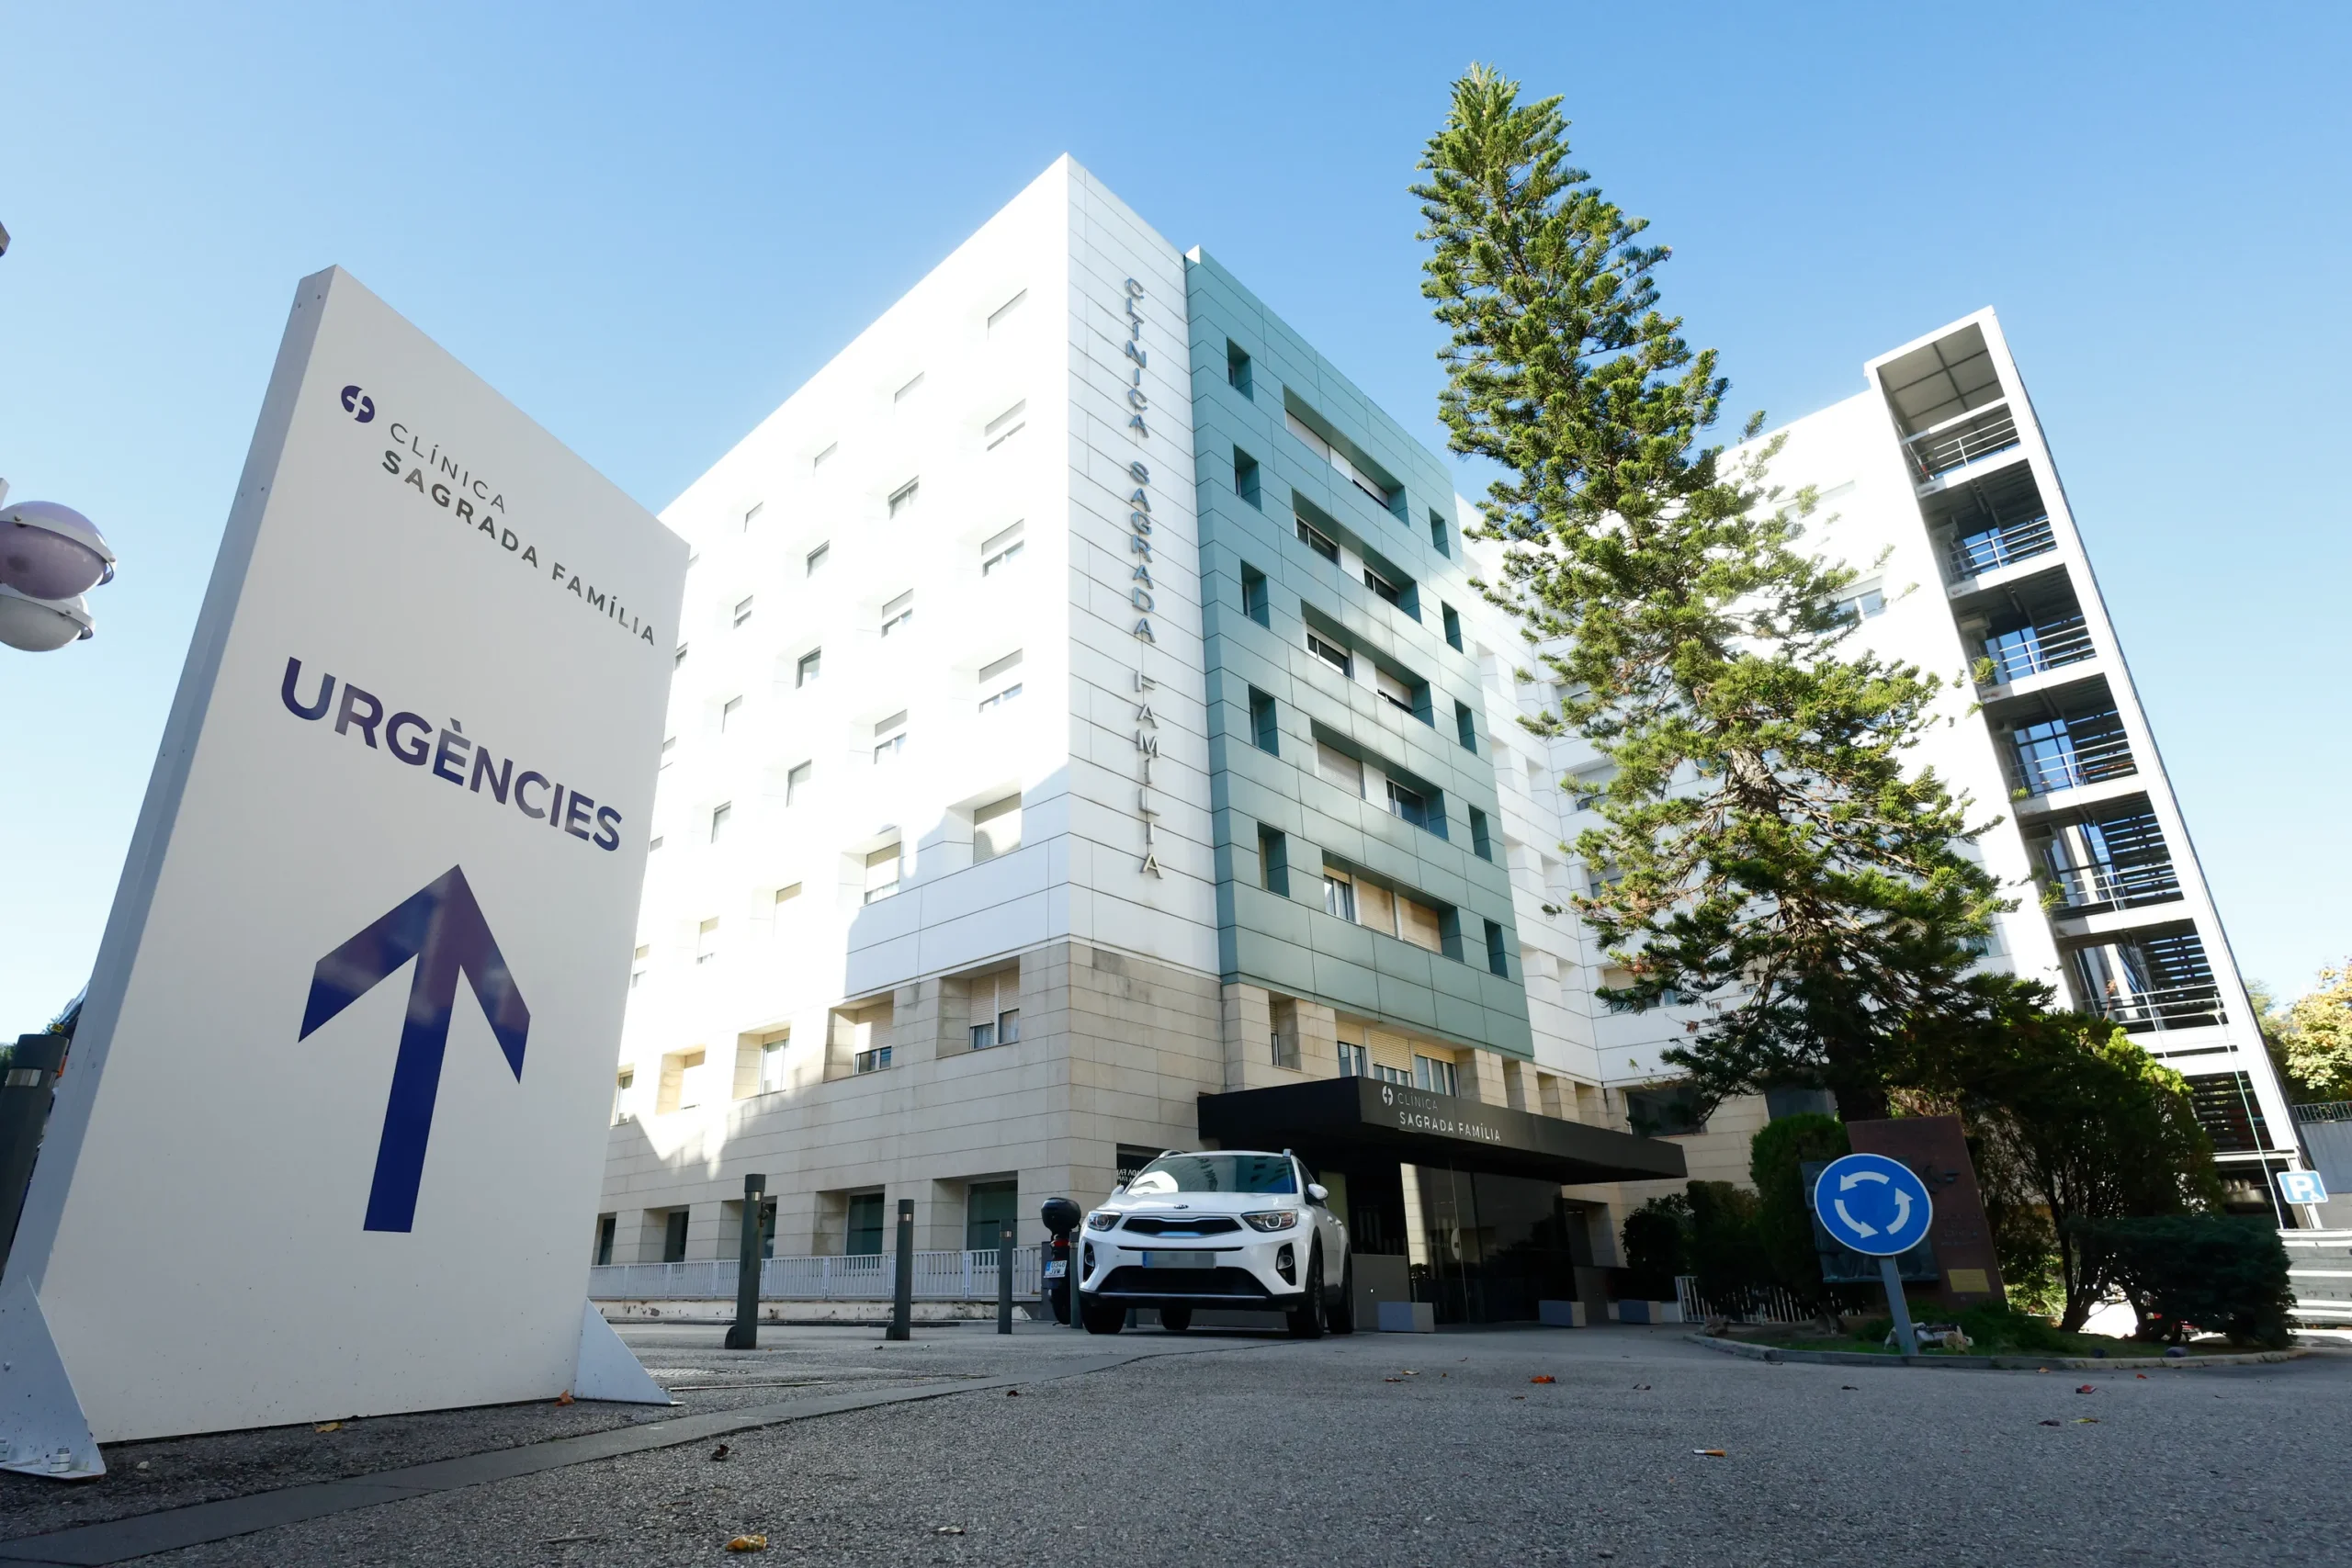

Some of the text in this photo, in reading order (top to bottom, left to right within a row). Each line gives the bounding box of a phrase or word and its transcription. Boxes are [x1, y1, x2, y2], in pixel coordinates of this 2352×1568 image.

[389, 422, 506, 514] CLÍNICA
[381, 449, 655, 647] SAGRADA FAMÍLIA
[1125, 277, 1163, 880] CLÍNICA SAGRADA FAMÍLIA
[280, 655, 624, 852] URGÈNCIES
[1397, 1092, 1439, 1111] CLÍNICA
[1399, 1111, 1500, 1141] SAGRADA FAMÍLIA
[2286, 1176, 2314, 1200] P
